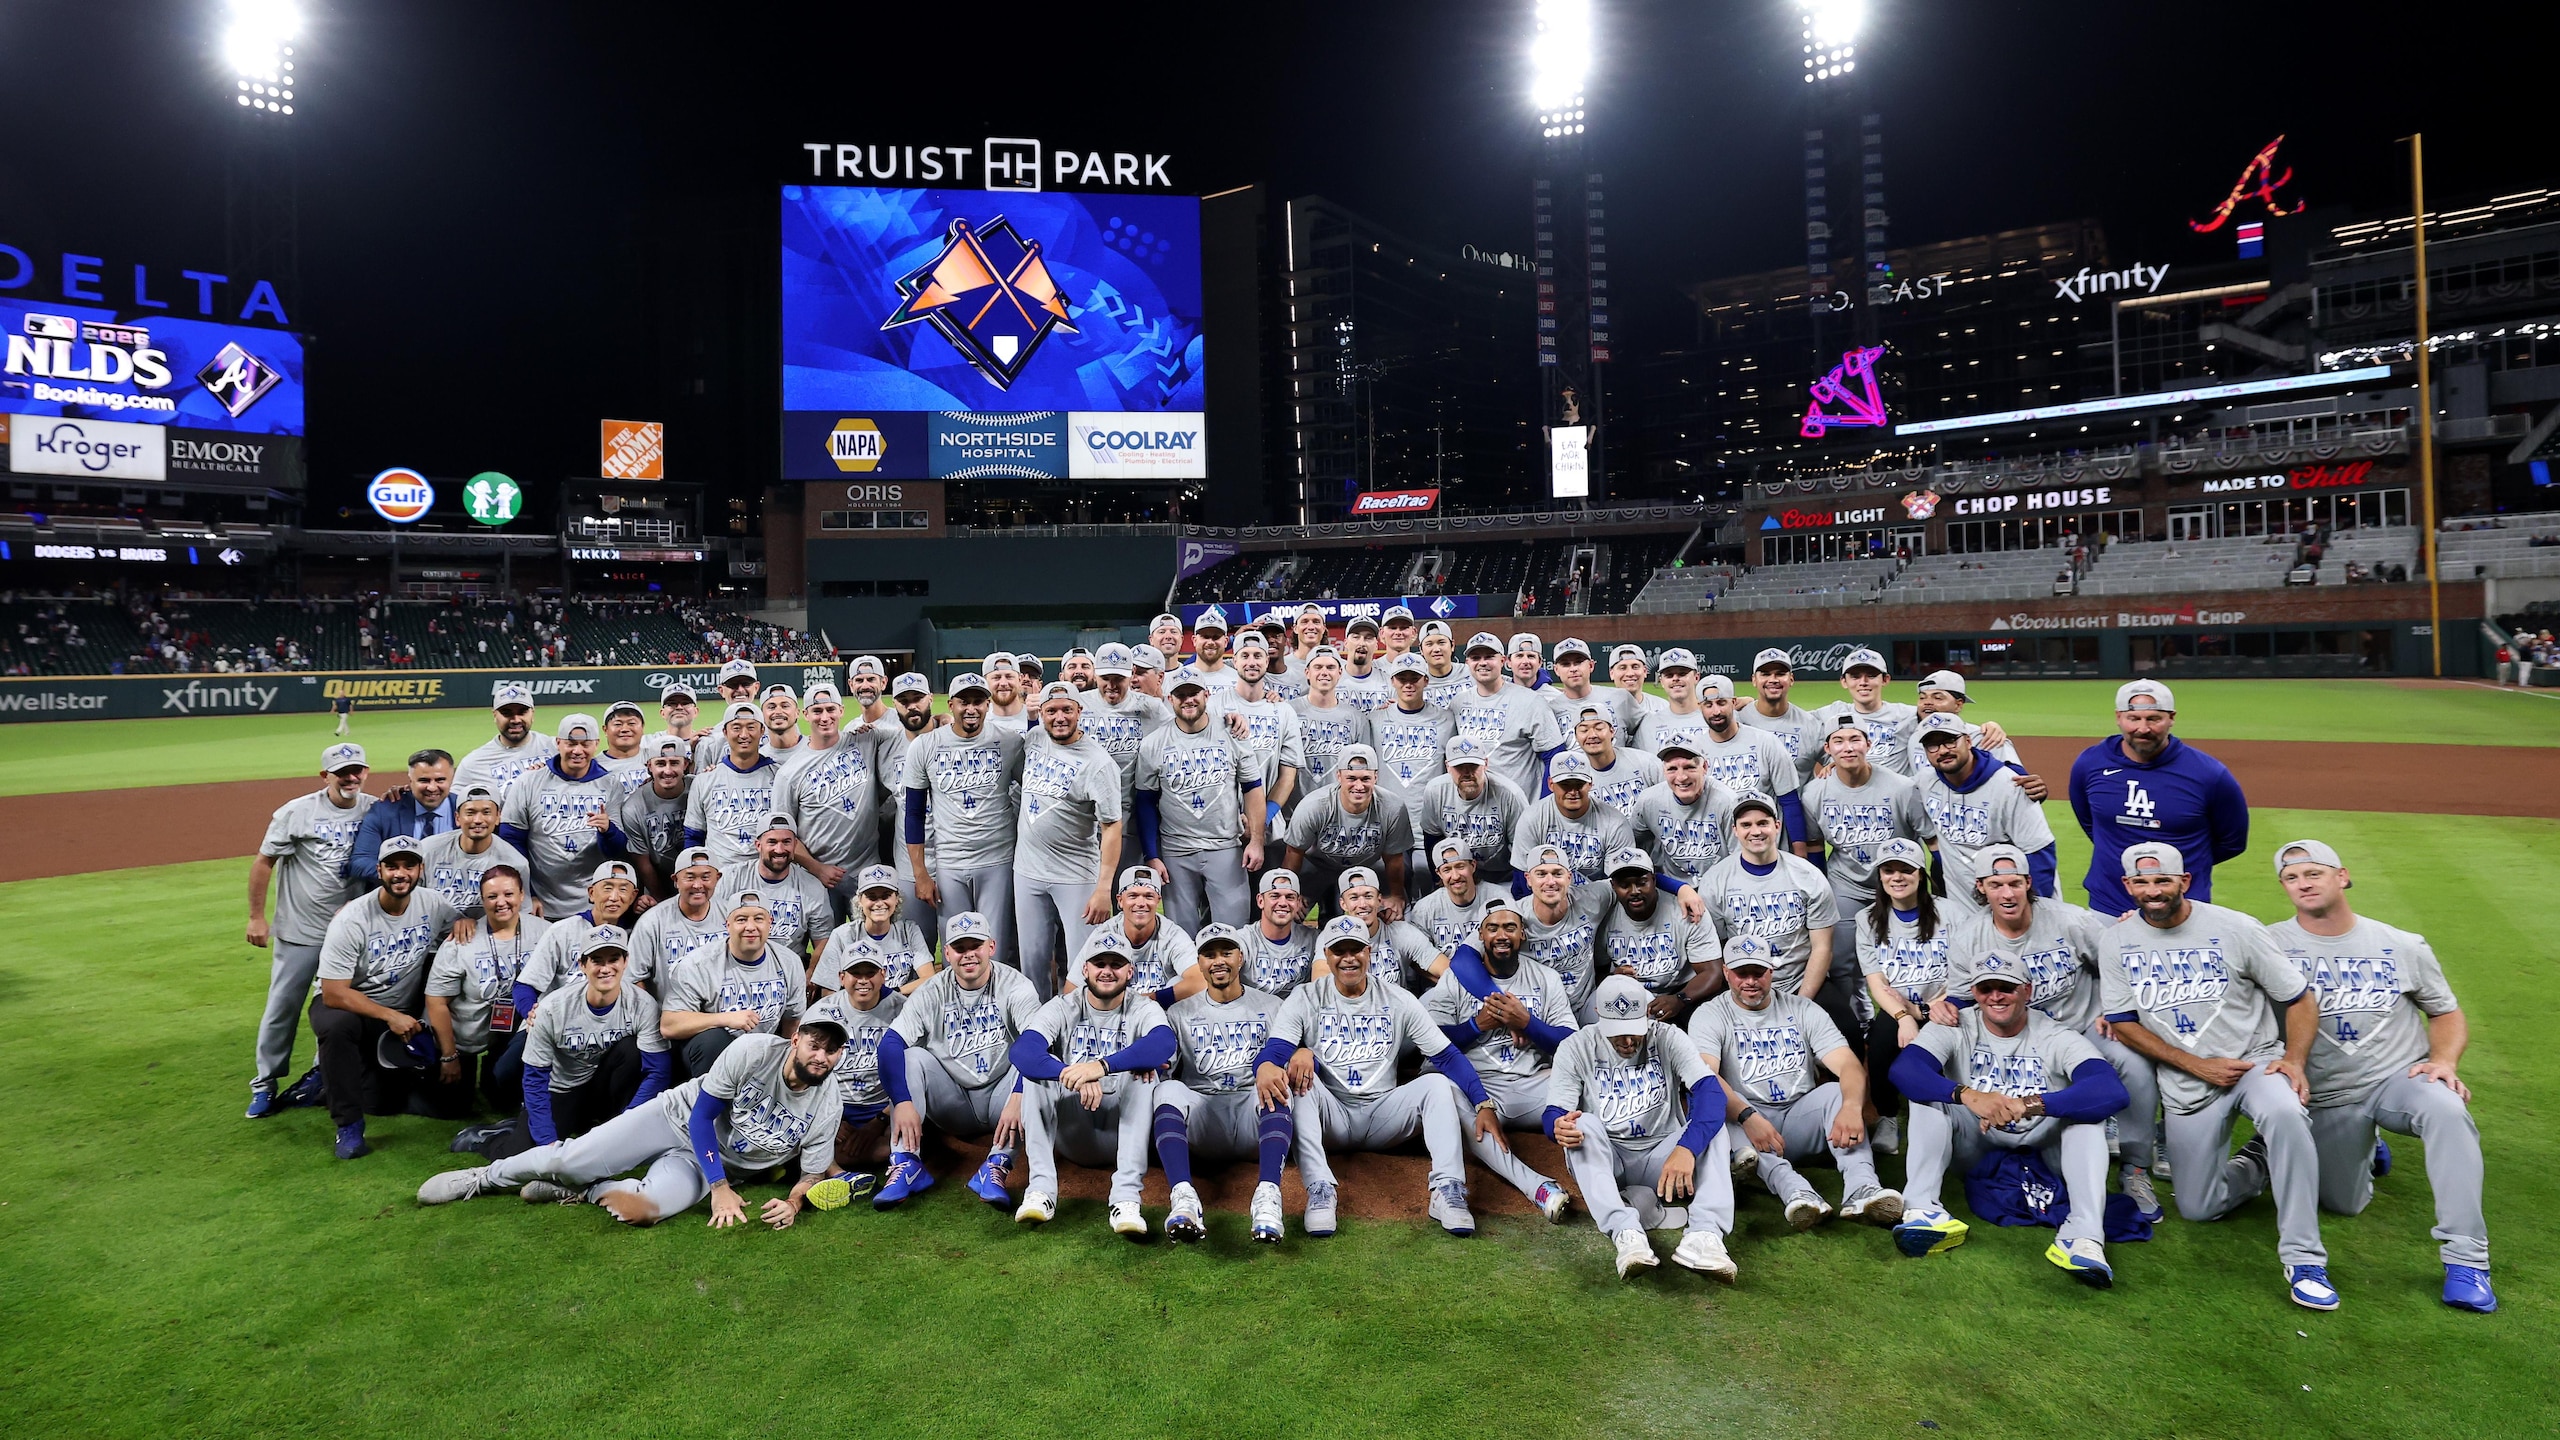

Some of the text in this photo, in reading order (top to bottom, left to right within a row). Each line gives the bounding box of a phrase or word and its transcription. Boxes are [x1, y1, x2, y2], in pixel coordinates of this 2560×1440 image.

[803, 143, 1172, 186] TRUIST PARK
[1462, 243, 1498, 266] OMNI
[0, 244, 289, 324] DELTA
[2055, 262, 2170, 303] xfinity
[5, 334, 172, 388] NLDS
[33, 383, 176, 411] Booking.com
[36, 424, 142, 471] Kroger
[604, 423, 662, 478] HOME
[608, 427, 632, 448] THE
[837, 434, 877, 457] NAPA
[940, 431, 1056, 447] NORTHSIDE
[1088, 430, 1198, 449] COOLRAY
[1561, 441, 1577, 450] EAT
[171, 439, 264, 464] EMORY
[627, 444, 662, 479] DEPOT
[961, 449, 1036, 458] HOSPITAL
[1561, 452, 1579, 461] MOR
[172, 460, 259, 473] HEALTHCARE
[1555, 462, 1584, 471] CHIKIN
[2203, 461, 2373, 492] MADE TO Chill
[374, 487, 427, 503] Gulf
[846, 485, 902, 501] ORIS
[1358, 495, 1428, 510] RaceTrac
[1955, 487, 2111, 515] CHOP HOUSE
[1782, 507, 1885, 529] Coors LIGHT
[35, 545, 167, 561] DODGERS vs BRAVES
[1341, 603, 1380, 617] BRAVES
[2010, 609, 2245, 630] Coors LIGHT BELOW CHOP
[803, 666, 834, 678] PAPA
[162, 680, 278, 713] xfinity
[323, 679, 443, 697] QUIKRETE
[0, 692, 107, 711] Wellstar
[1079, 716, 1143, 741] TAKE
[1459, 706, 1506, 730] TAKE
[1382, 725, 1437, 748] TAKE
[806, 748, 865, 789] TAKE
[935, 750, 1002, 776] TAKE
[1163, 748, 1229, 775] TAKE
[2125, 780, 2155, 817] LA
[1443, 812, 1504, 835] TAKE
[1658, 815, 1718, 841] TAKE
[1824, 804, 1894, 829] TAKE
[434, 867, 483, 892] TAK
[1728, 893, 1807, 924] TAKE
[368, 921, 431, 962] TAKE
[1529, 926, 1593, 962] TAKE
[1607, 932, 1677, 959] TAKE
[1256, 955, 1309, 983] TAKE
[2122, 948, 2228, 985] TAKE
[721, 979, 787, 1009] TAKE
[2134, 971, 2228, 1011] October
[945, 1002, 1003, 1035] TAKE
[1319, 1013, 1394, 1044] TAKE
[2172, 1008, 2196, 1033] LA
[2336, 1016, 2359, 1040] LA
[1191, 1021, 1267, 1052] TAKE
[1734, 1027, 1804, 1057] TAKE
[1596, 1058, 1664, 1099] TAKE
[1970, 1050, 2046, 1086] TAKE
[733, 1080, 810, 1146] TAKE
